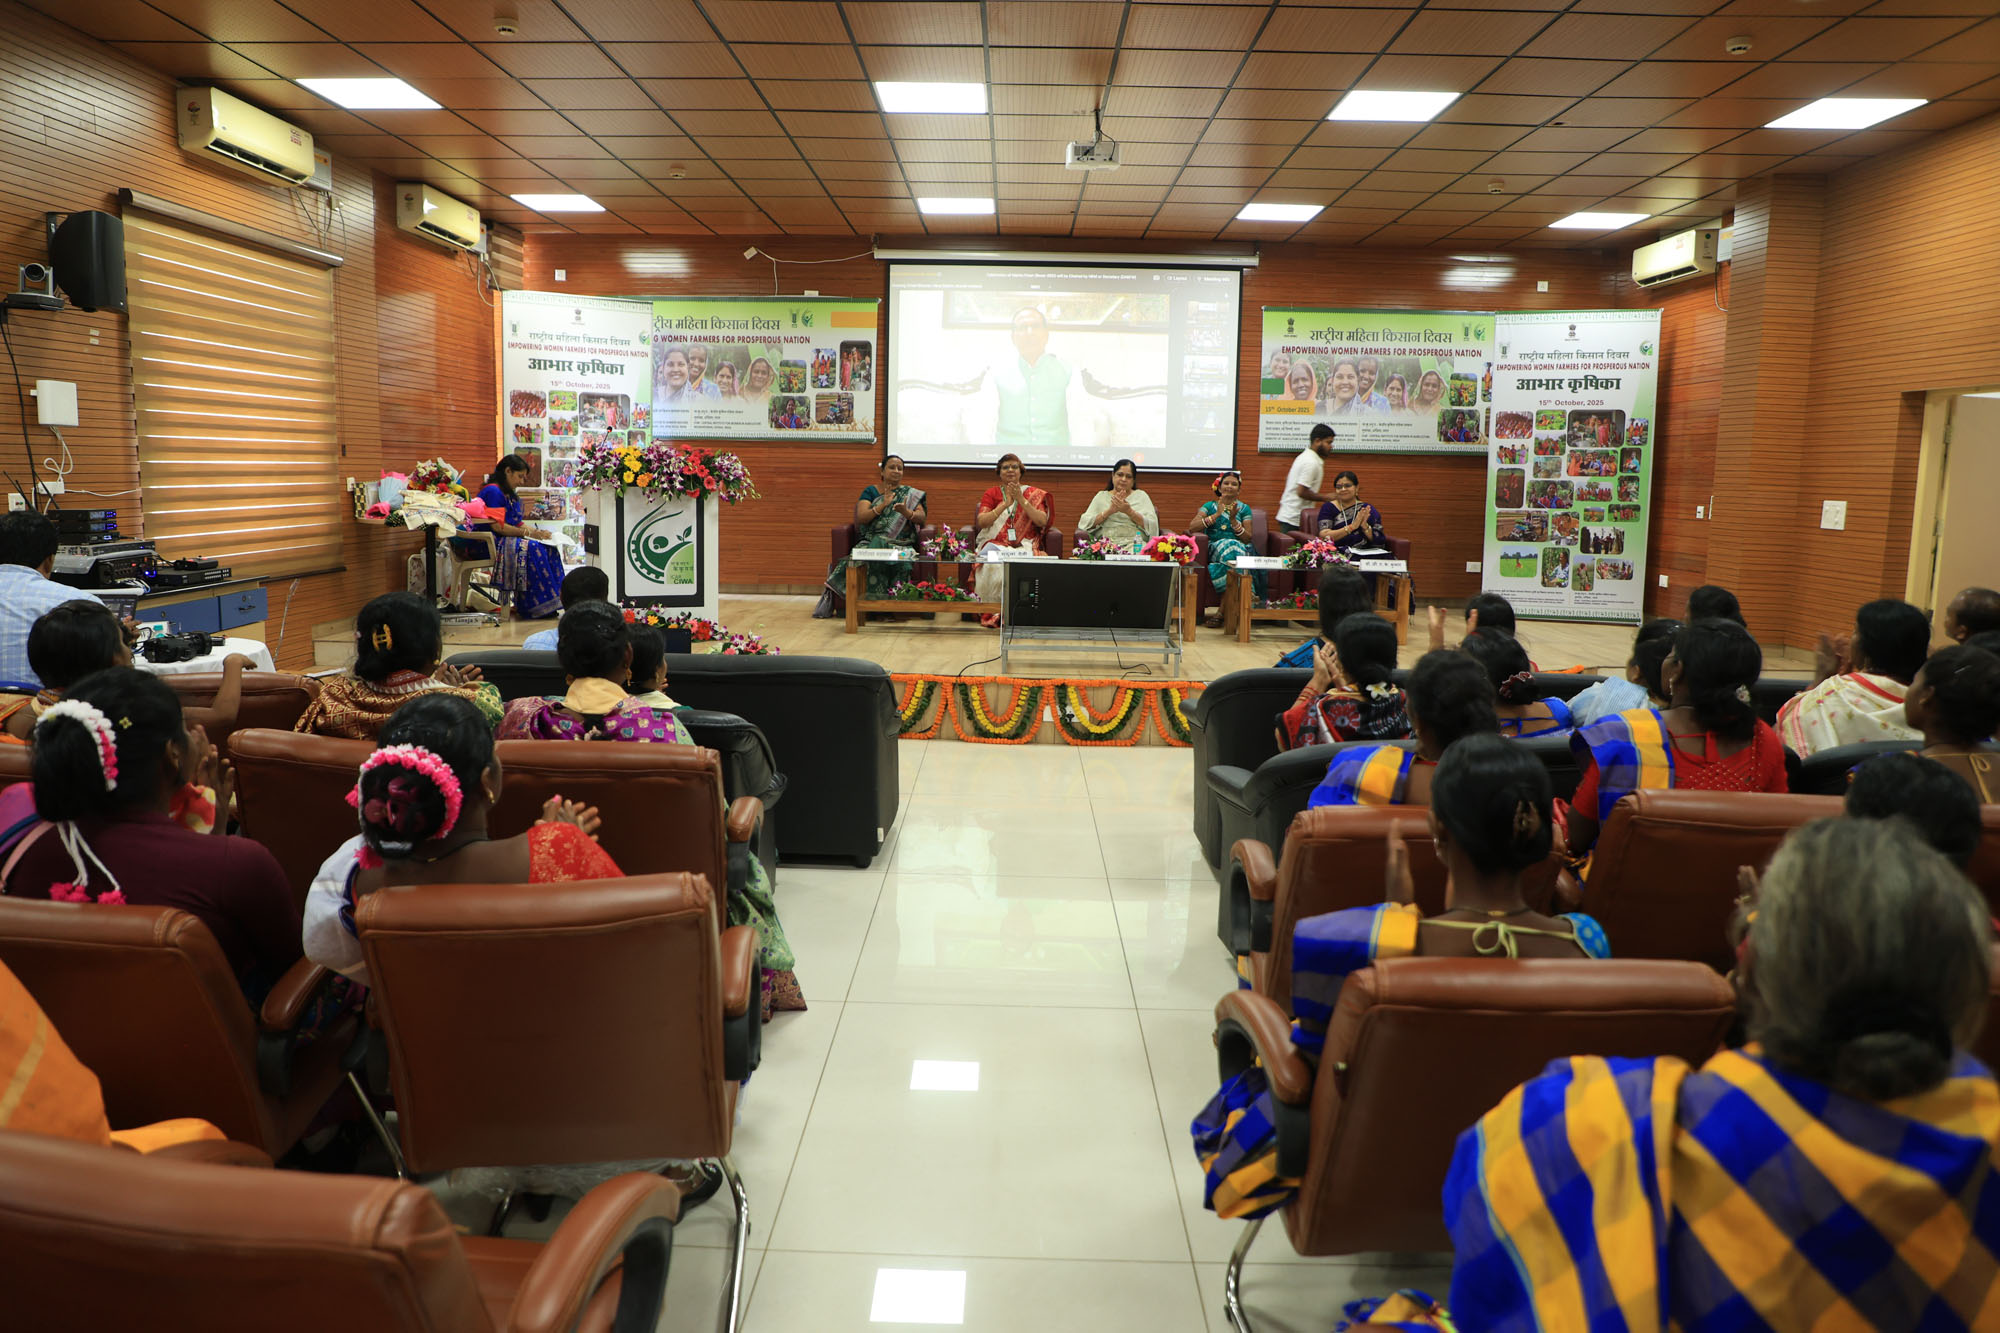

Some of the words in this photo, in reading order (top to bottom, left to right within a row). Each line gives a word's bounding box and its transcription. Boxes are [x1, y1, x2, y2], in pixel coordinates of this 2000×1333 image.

[653, 316, 672, 332] ट्रीय
[676, 315, 708, 330] महिला
[710, 316, 749, 330] किसान
[751, 316, 780, 331] दिवस
[528, 332, 554, 344] राष्ट्रीय
[554, 332, 580, 343] महिला
[583, 334, 608, 345] किसान
[610, 336, 631, 346] दिवस
[660, 335, 688, 343] WOMEN
[690, 335, 720, 344] FARMERS
[722, 336, 736, 344] FOR
[737, 336, 782, 344] PROSPEROUS
[784, 336, 811, 344] NATION
[1310, 327, 1343, 345] राष्ट्रीय
[1346, 328, 1379, 342] महिला
[1382, 328, 1421, 343] किसान
[1423, 330, 1453, 344] दिवस
[508, 342, 542, 351] EMPOWERING
[544, 344, 564, 352] WOMEN
[564, 345, 586, 354] FARMERS
[588, 346, 598, 355] FOR
[598, 348, 629, 357] PROSPEROUS
[630, 350, 649, 358] NATION
[1282, 346, 1329, 355] EMPOWERING
[1331, 347, 1358, 355] WOMEN
[1360, 348, 1391, 356] FARMERS
[1393, 348, 1407, 356] FOR
[1409, 348, 1453, 357] PROSPEROUS
[1455, 349, 1482, 357] NATION
[1519, 350, 1544, 362] राष्ट्रीय
[1547, 350, 1574, 360] महिला
[1576, 350, 1604, 360] किसान
[1606, 348, 1630, 360] दिवस
[528, 357, 573, 372] आभार
[576, 358, 625, 376] कृषिका
[1496, 363, 1532, 371] EMPOWERING
[1534, 363, 1555, 371] WOMEN
[1628, 362, 1650, 370] NATION
[1516, 378, 1565, 391] आभार
[1568, 375, 1622, 393] कृषिका
